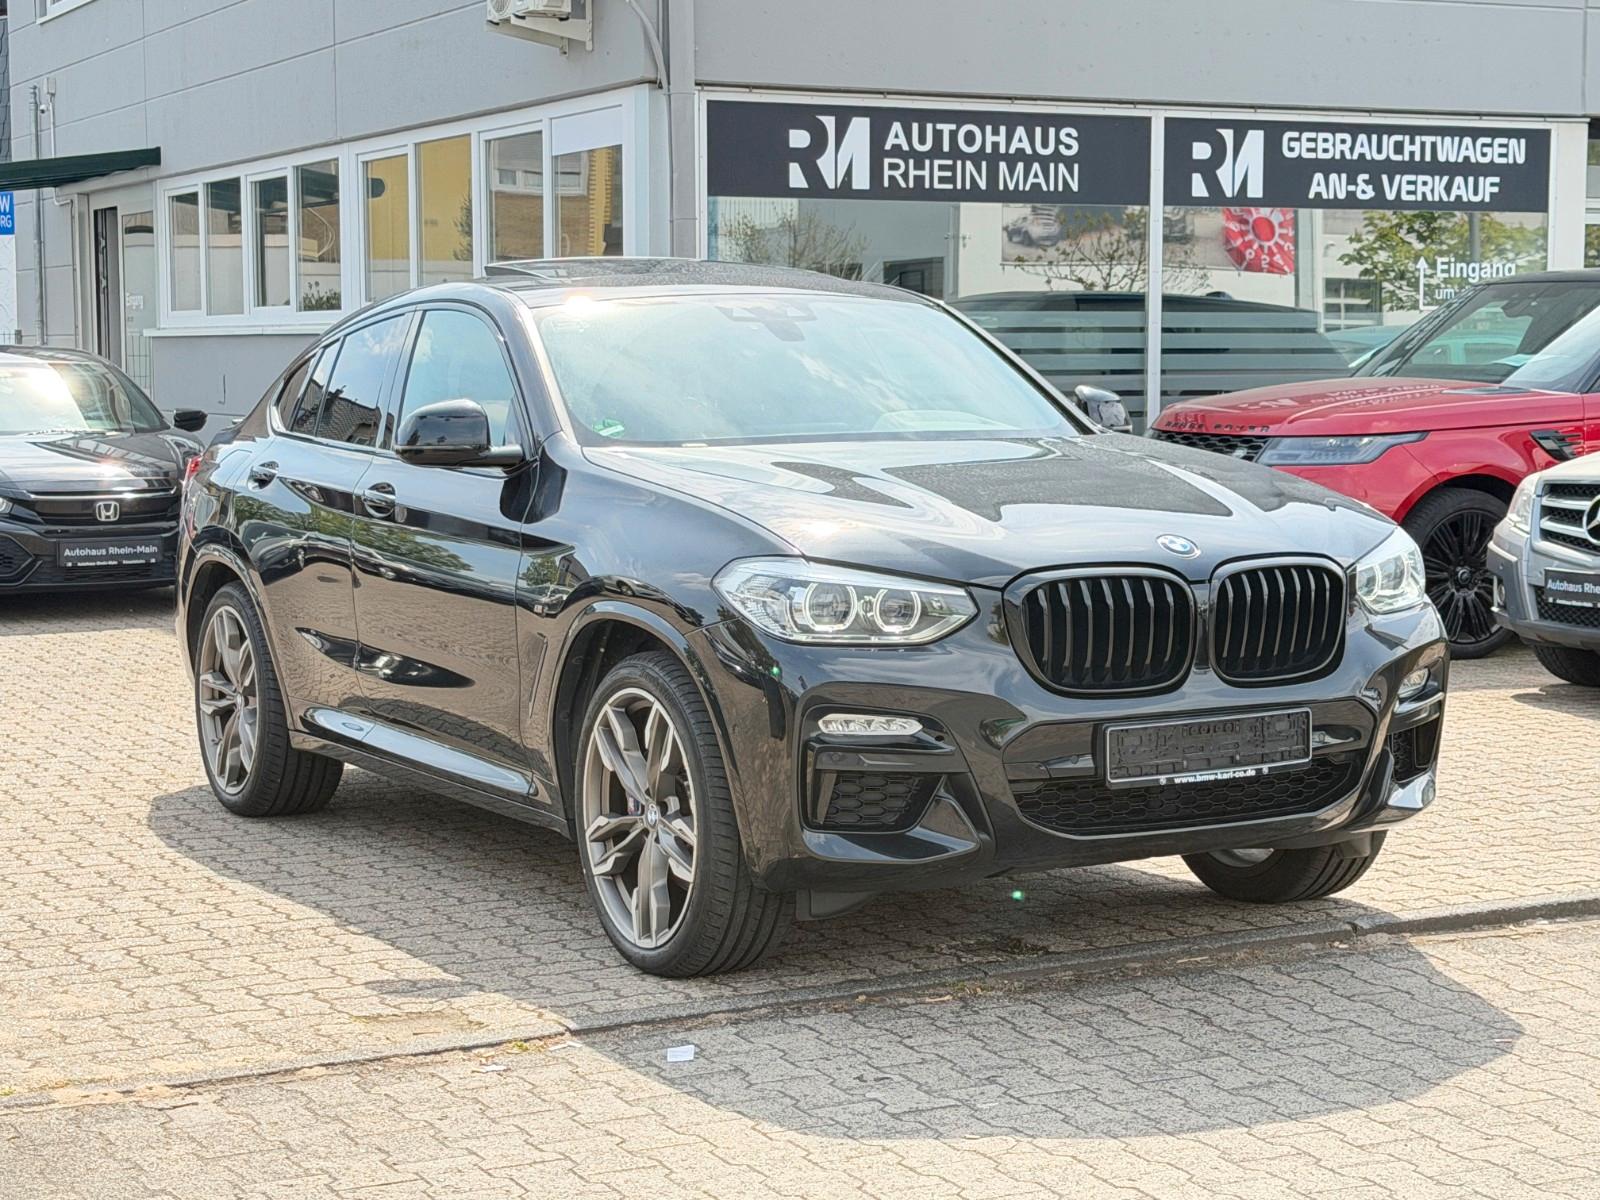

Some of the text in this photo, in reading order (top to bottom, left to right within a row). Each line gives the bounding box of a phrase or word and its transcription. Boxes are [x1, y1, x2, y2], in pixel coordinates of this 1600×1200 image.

[884, 121, 1080, 157] AUTOHAUS
[1281, 130, 1527, 165] GEBRAUCHTWAGEN
[883, 158, 1080, 193] RHEIN MAIN
[1308, 172, 1501, 203] AN-& VERKAUF
[0, 214, 12, 228] RG
[64, 545, 158, 557] Autohaus Rhein-Main
[1546, 578, 1582, 592] Autohaus
